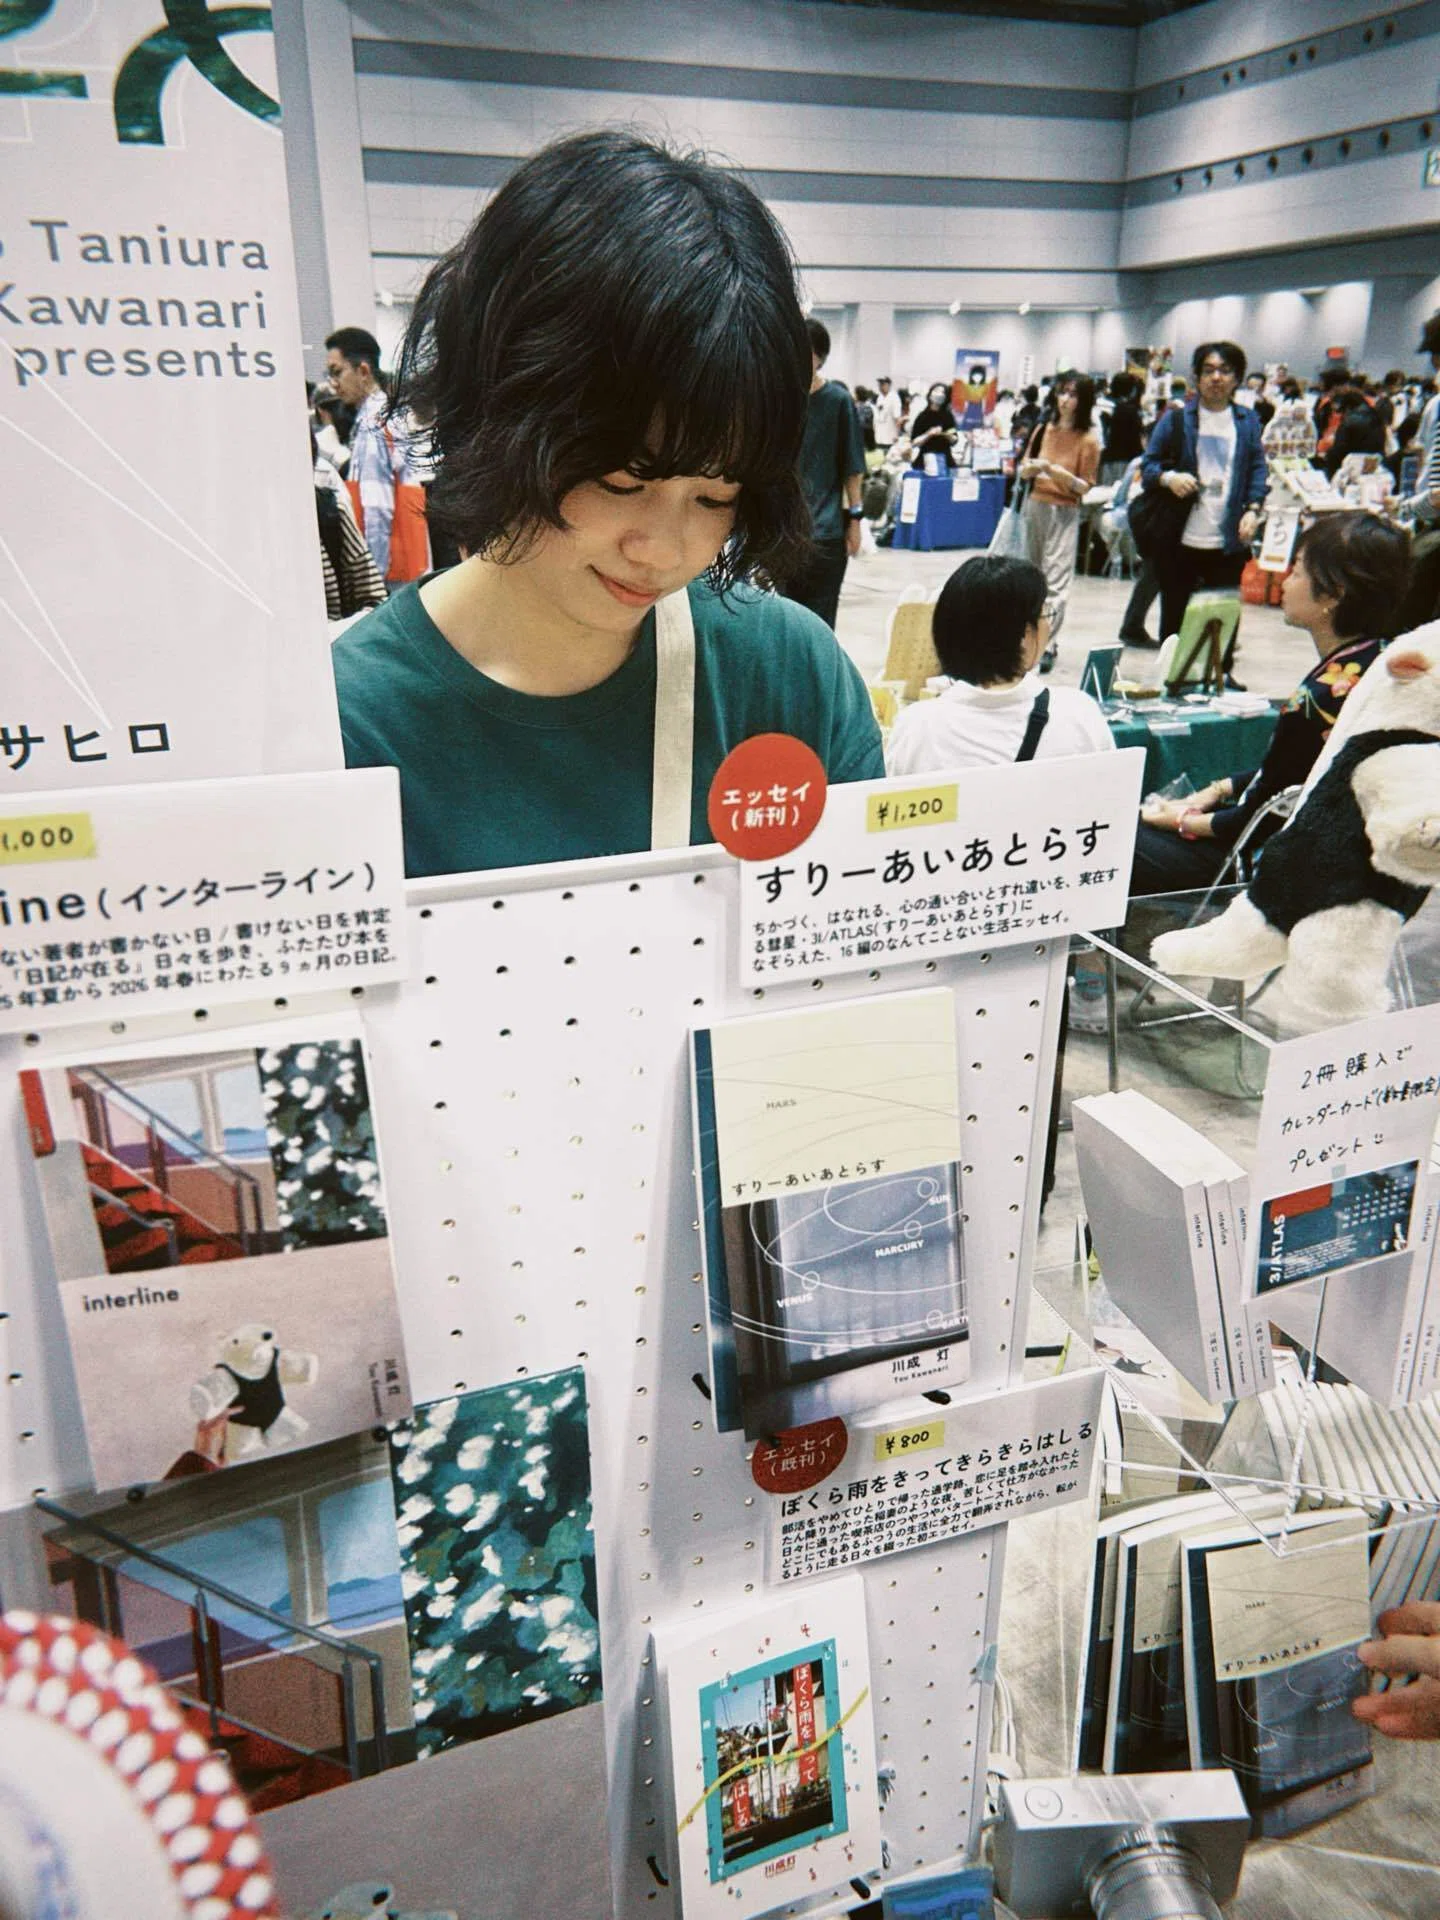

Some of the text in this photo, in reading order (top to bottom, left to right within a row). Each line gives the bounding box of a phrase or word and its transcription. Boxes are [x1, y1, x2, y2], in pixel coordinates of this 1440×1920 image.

[29, 220, 269, 270] Taniura
[14, 342, 277, 387] presents
[0, 722, 170, 770] サヒロ
[721, 781, 812, 806] エッセイ
[730, 804, 800, 831] (新刊)
[757, 820, 1110, 903] すりーあいあとらす
[732, 1158, 886, 1196] すりーあいあとらす
[83, 1286, 180, 1313] interline
[762, 1432, 836, 1461] エッセイ
